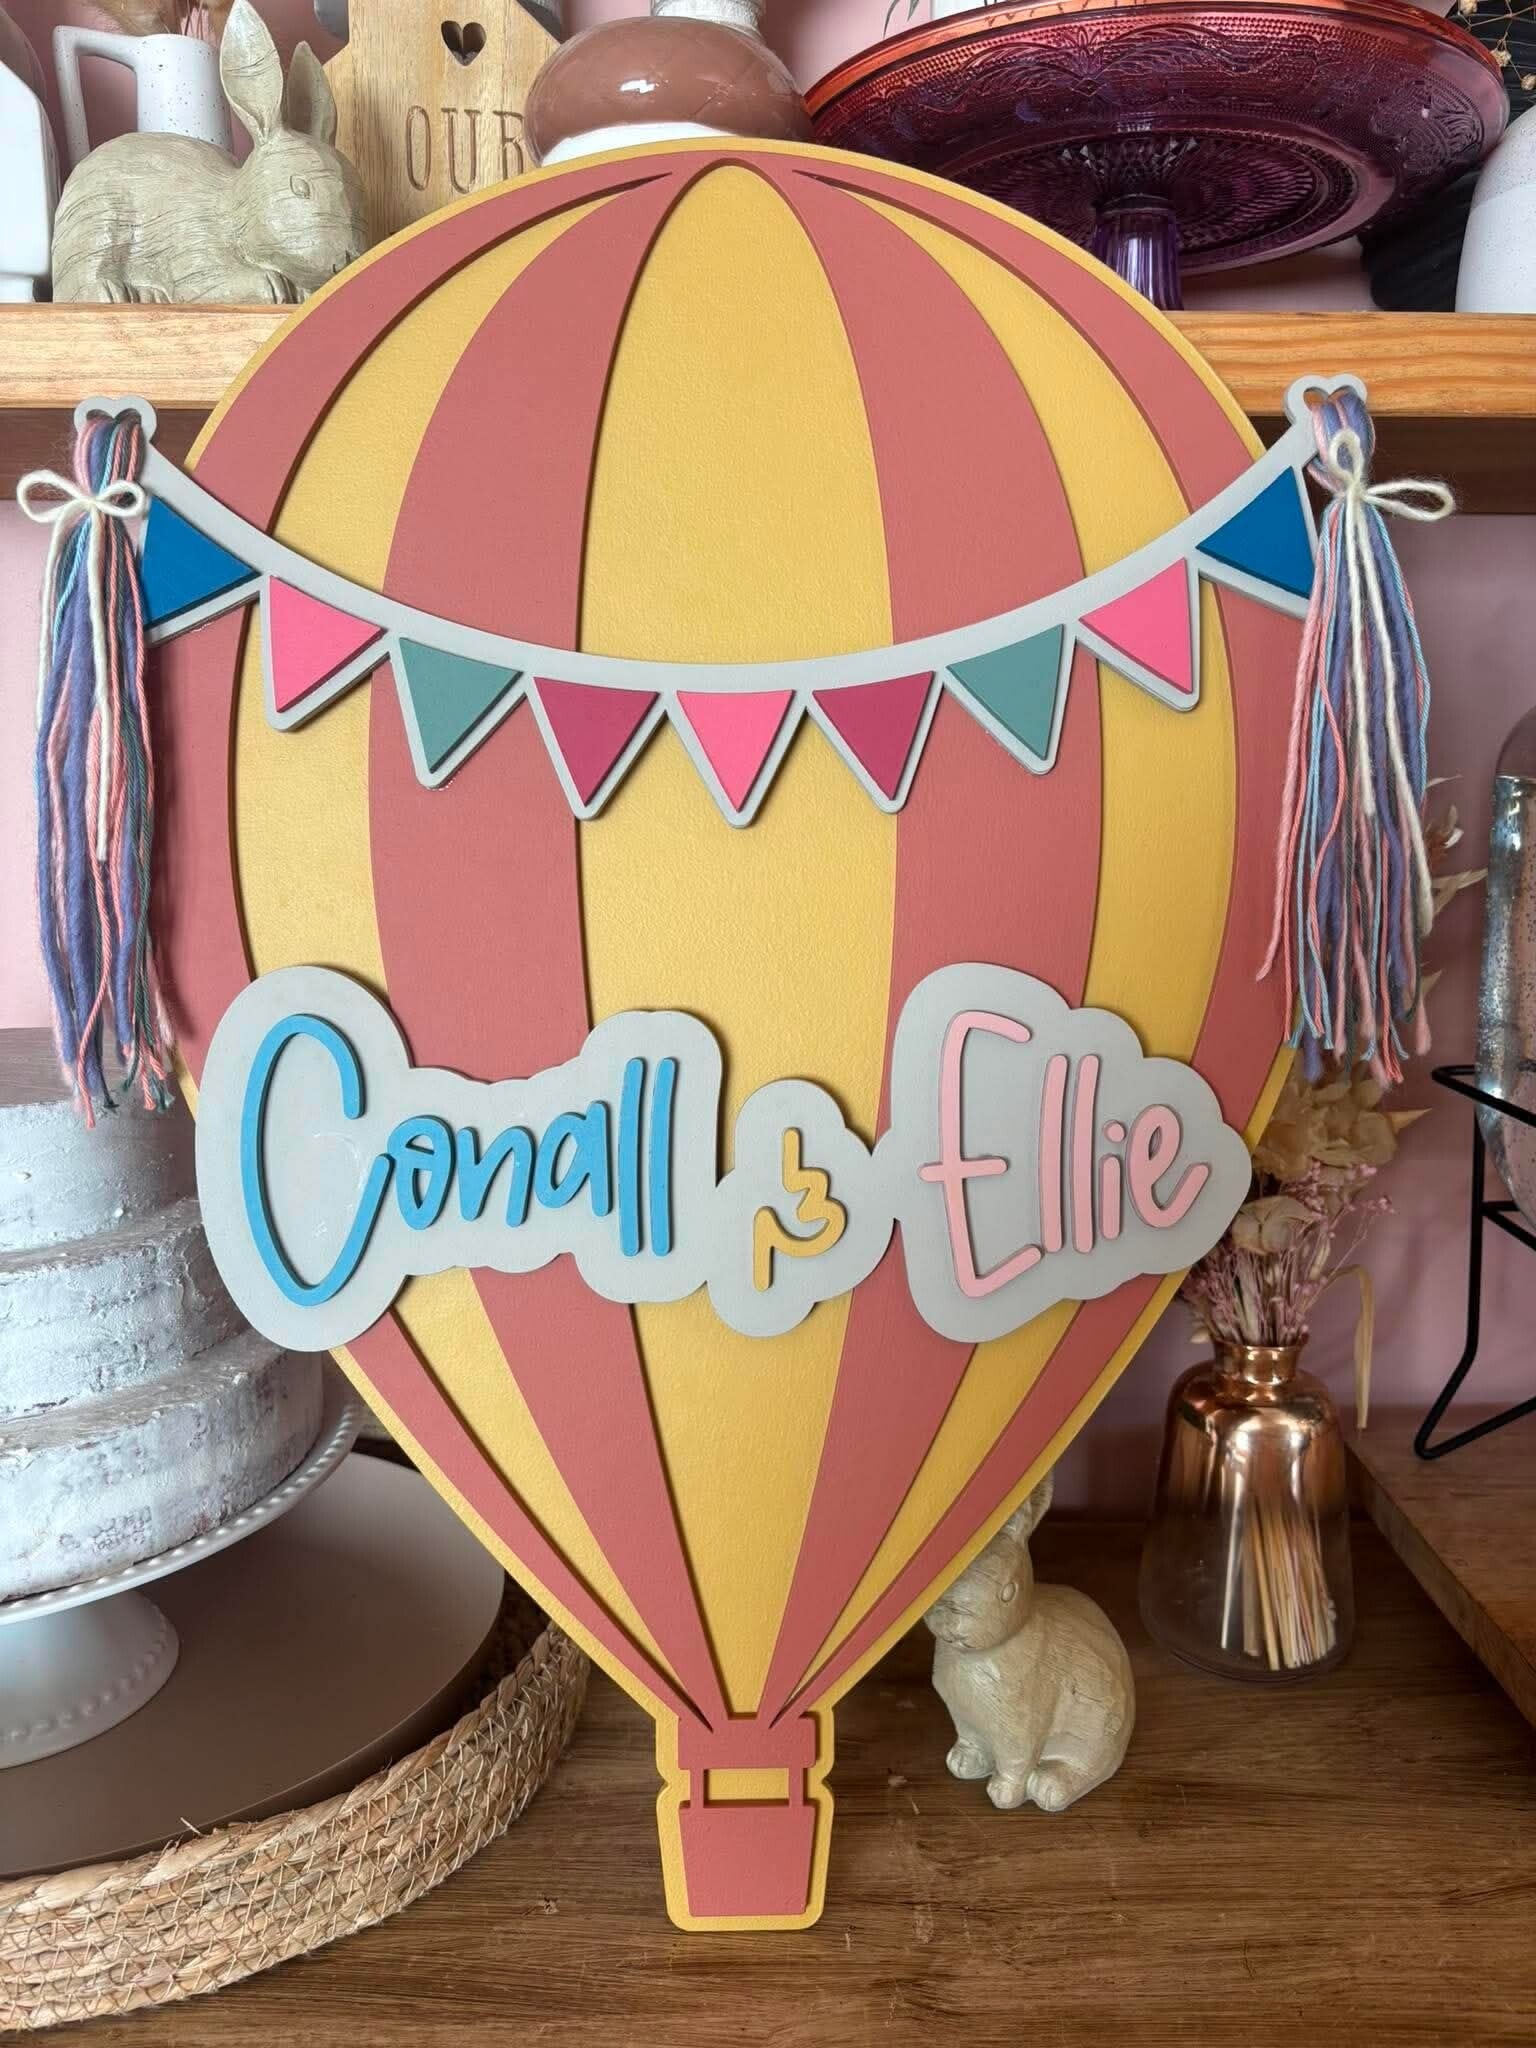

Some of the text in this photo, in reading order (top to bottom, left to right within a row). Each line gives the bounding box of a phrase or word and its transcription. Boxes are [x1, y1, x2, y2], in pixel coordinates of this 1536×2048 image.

[406, 105, 524, 194] OUR
[240, 1013, 677, 1306] Conall
[917, 1010, 1209, 1298] Ellie
